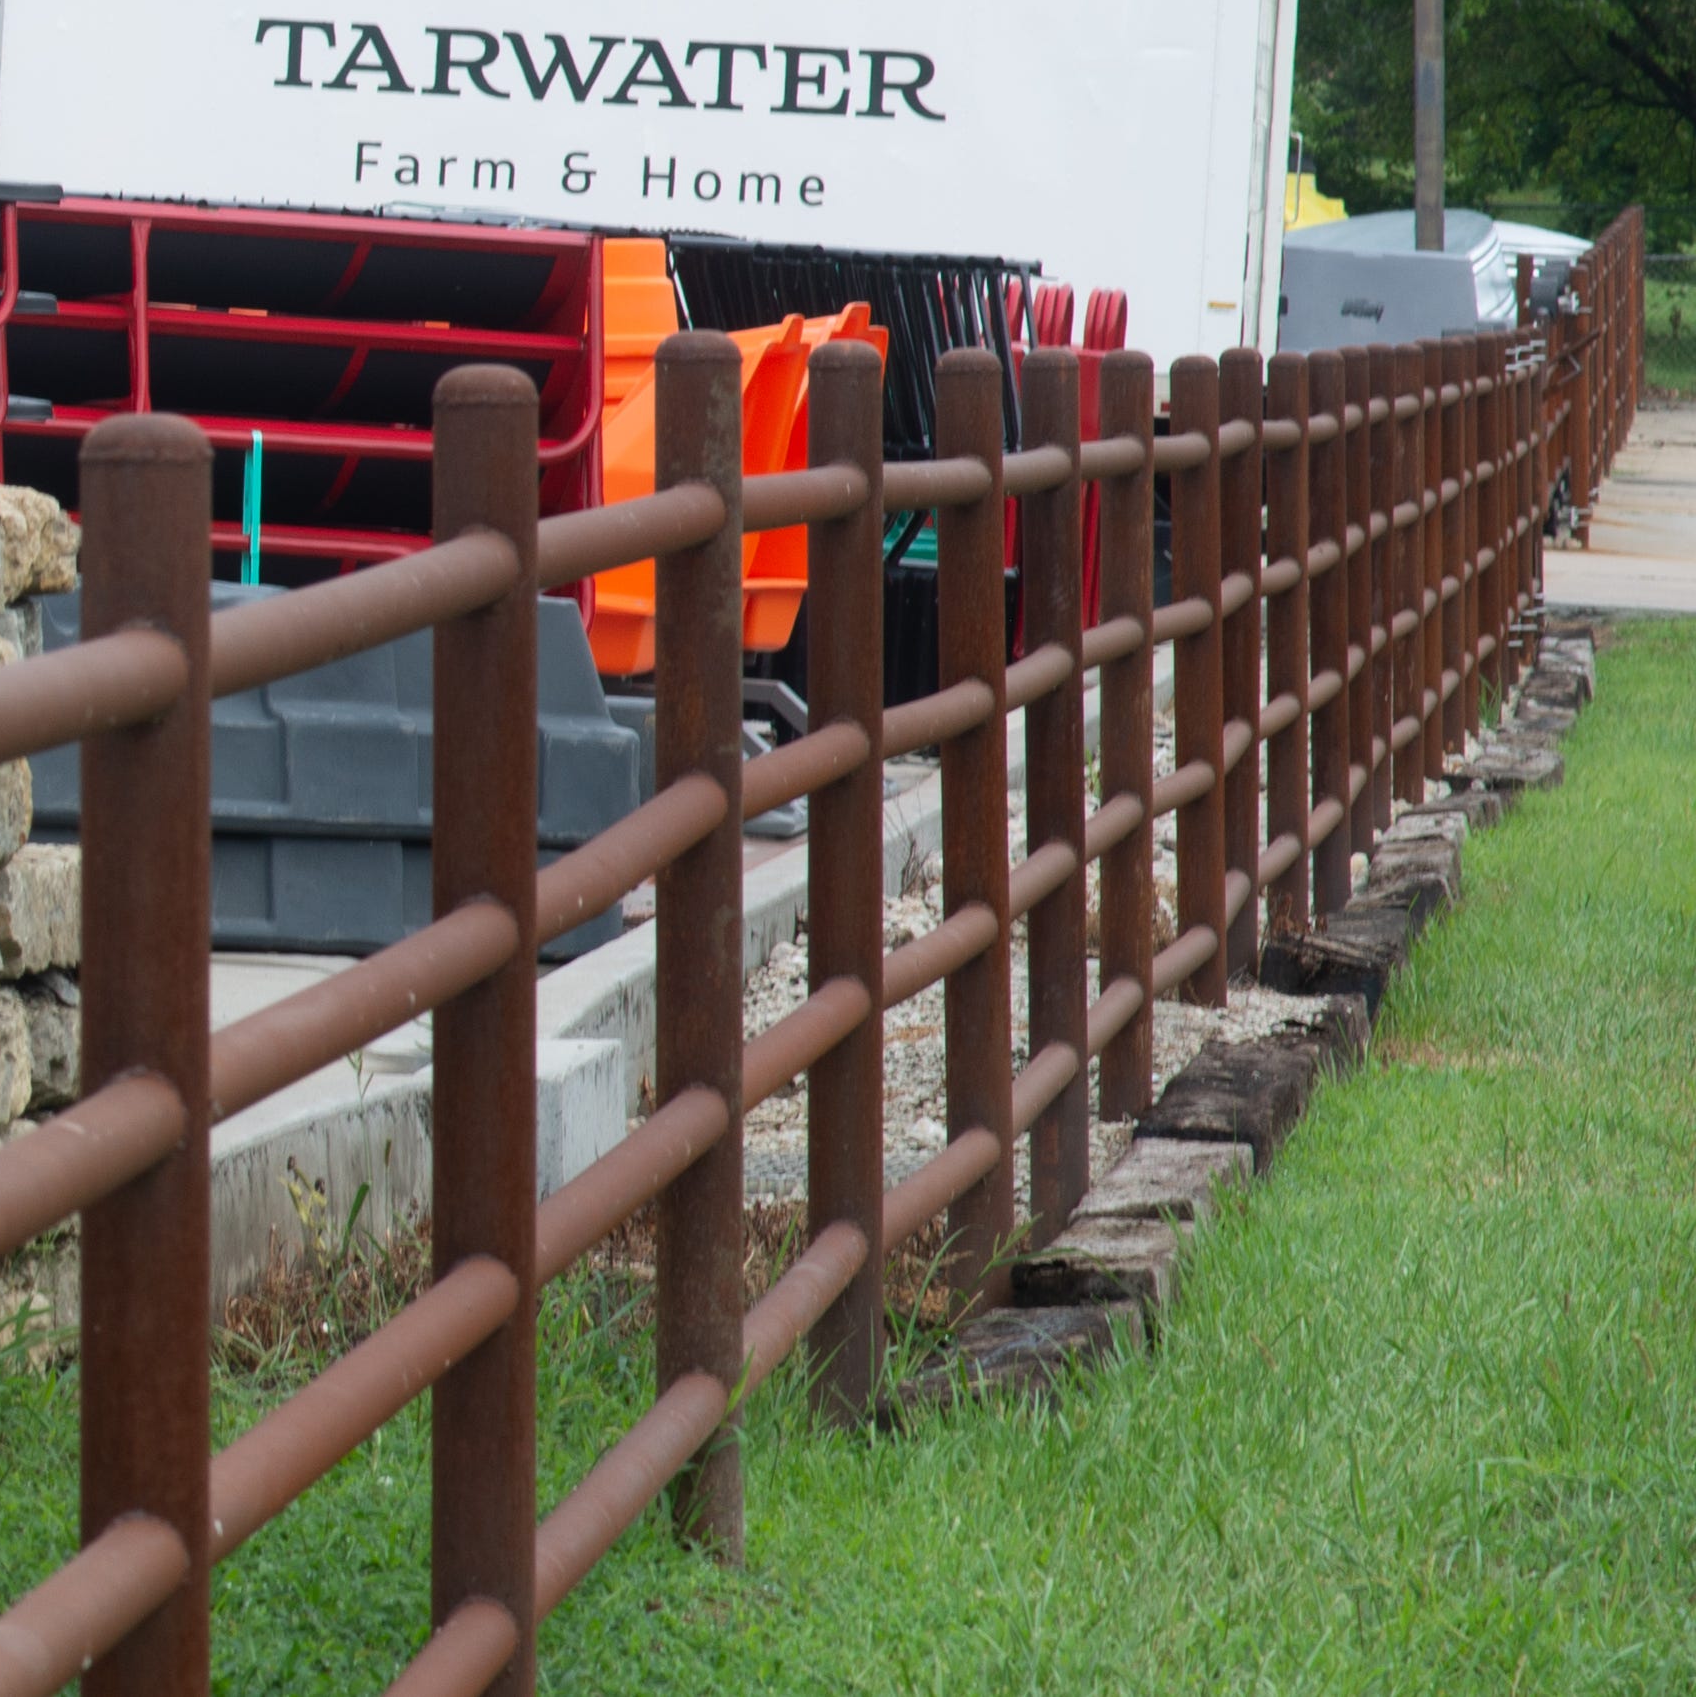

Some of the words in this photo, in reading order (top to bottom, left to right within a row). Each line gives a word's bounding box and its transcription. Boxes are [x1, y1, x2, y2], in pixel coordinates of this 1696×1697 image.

[254, 18, 947, 122] TARWATER
[354, 140, 516, 192] Farm
[561, 151, 598, 194] &
[642, 155, 827, 206] Home
